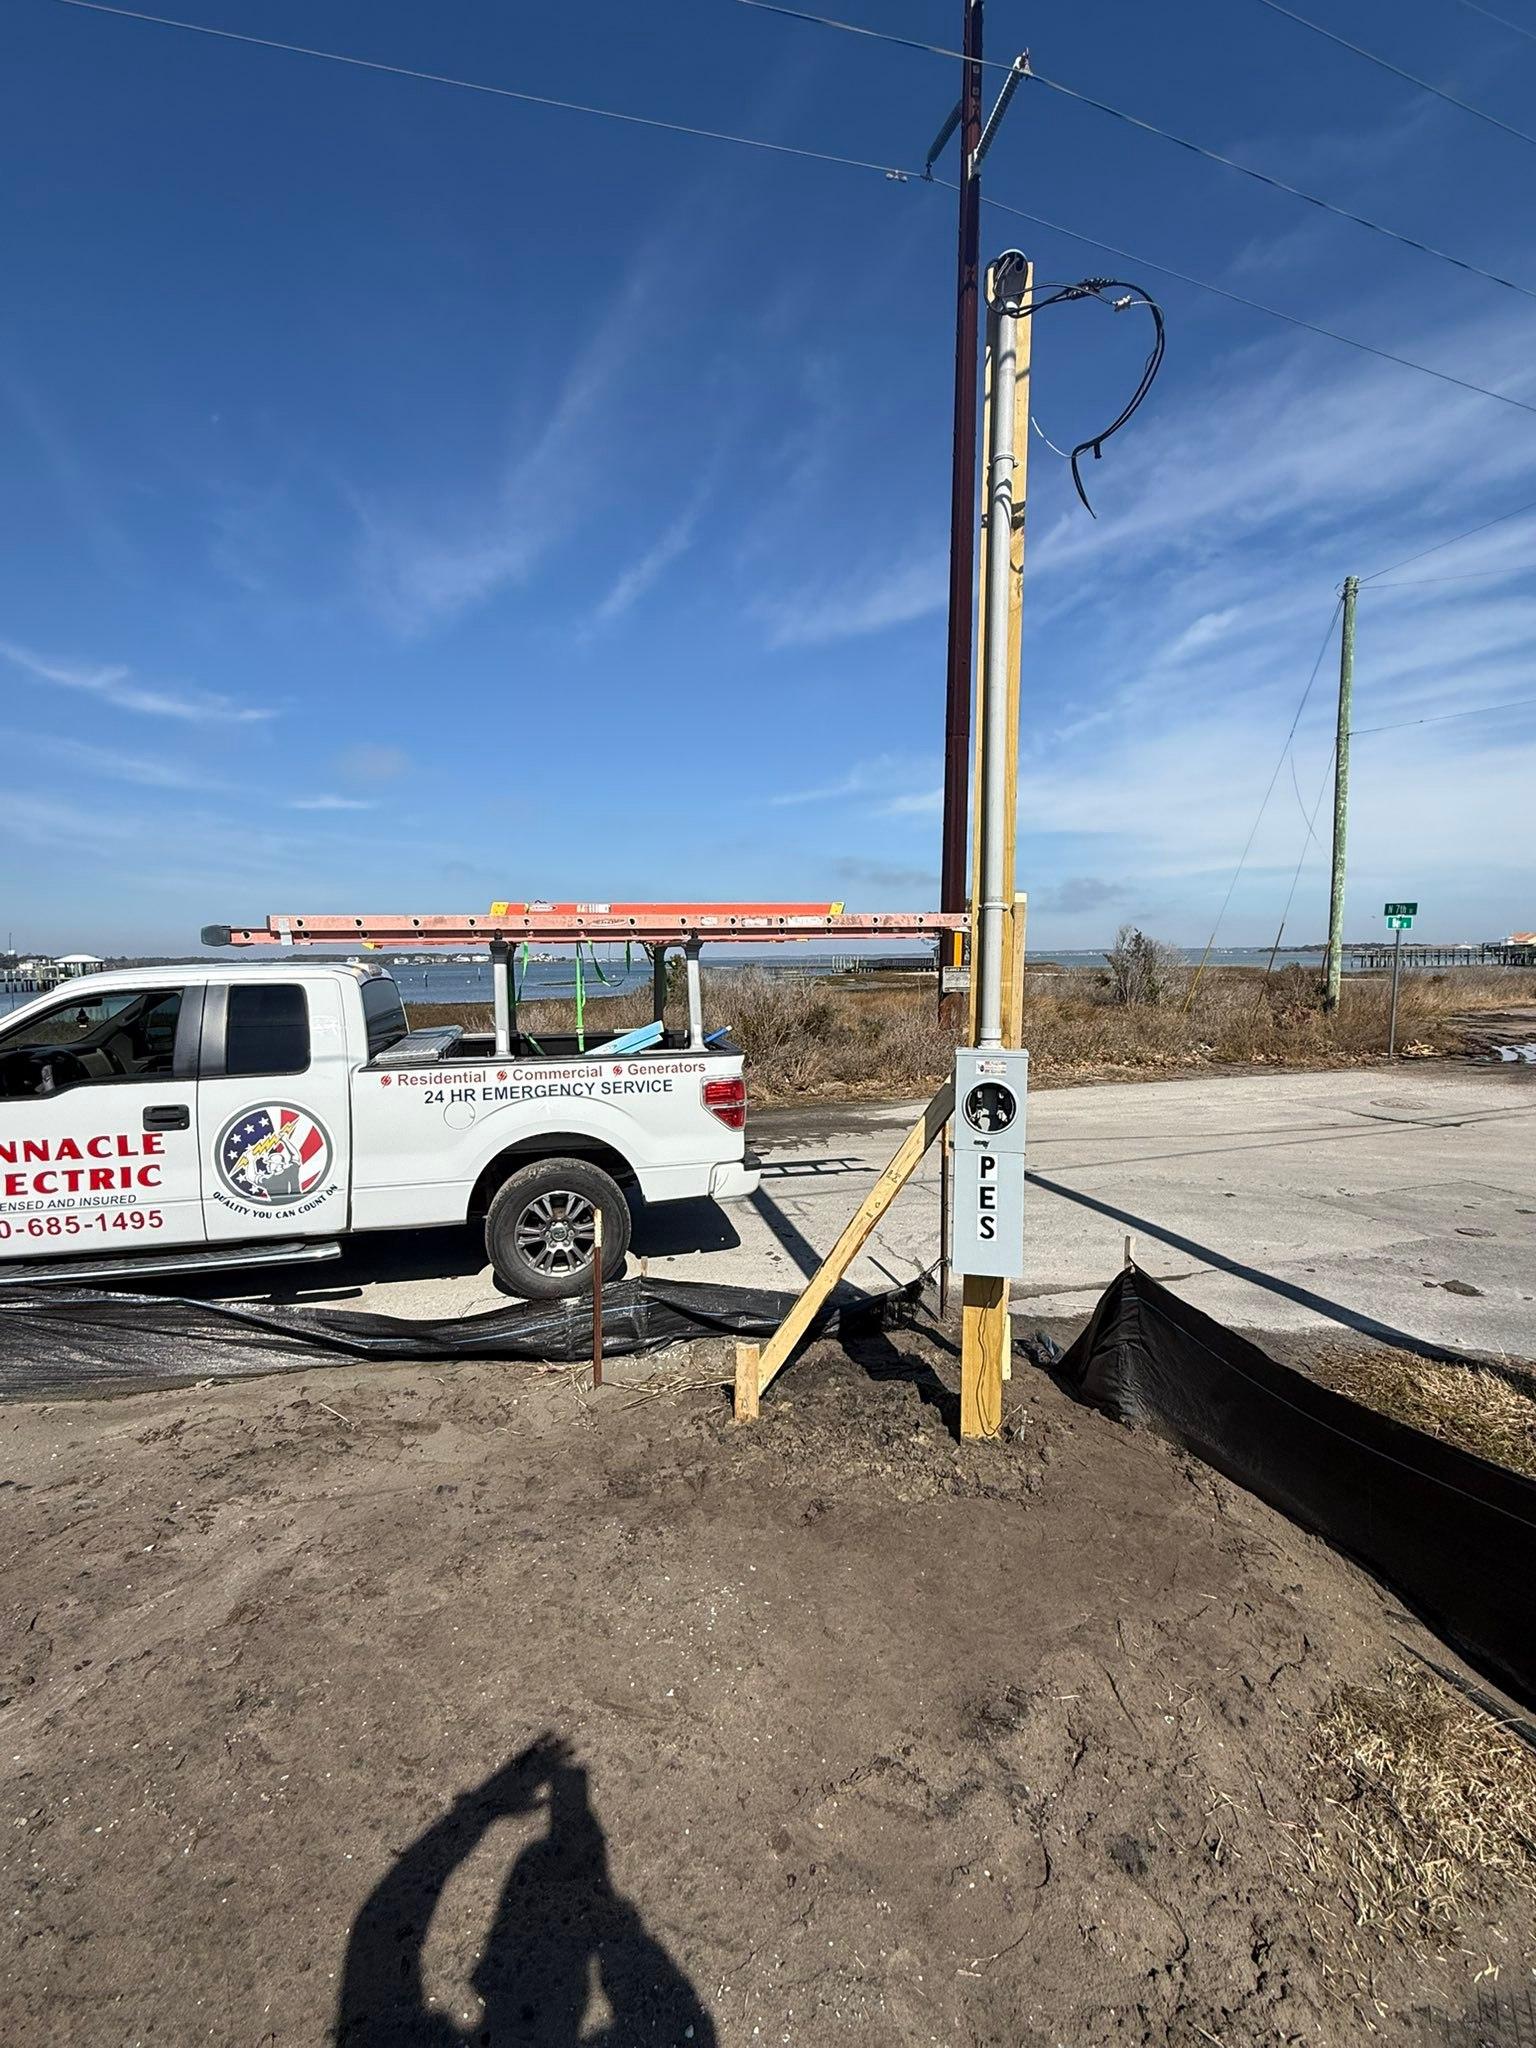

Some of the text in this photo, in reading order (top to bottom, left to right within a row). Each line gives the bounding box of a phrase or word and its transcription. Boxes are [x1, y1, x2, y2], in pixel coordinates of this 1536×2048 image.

[397, 1062, 707, 1086] Residential Commercial Generators
[424, 1079, 674, 1104] 24 HR EMERGENCY SERVICE
[5, 1164, 163, 1196] ECTRIC
[47, 1196, 76, 1209] AND
[79, 1194, 138, 1207] INSURED
[212, 1183, 339, 1219] QUALITY YOU CAN COUNT ON
